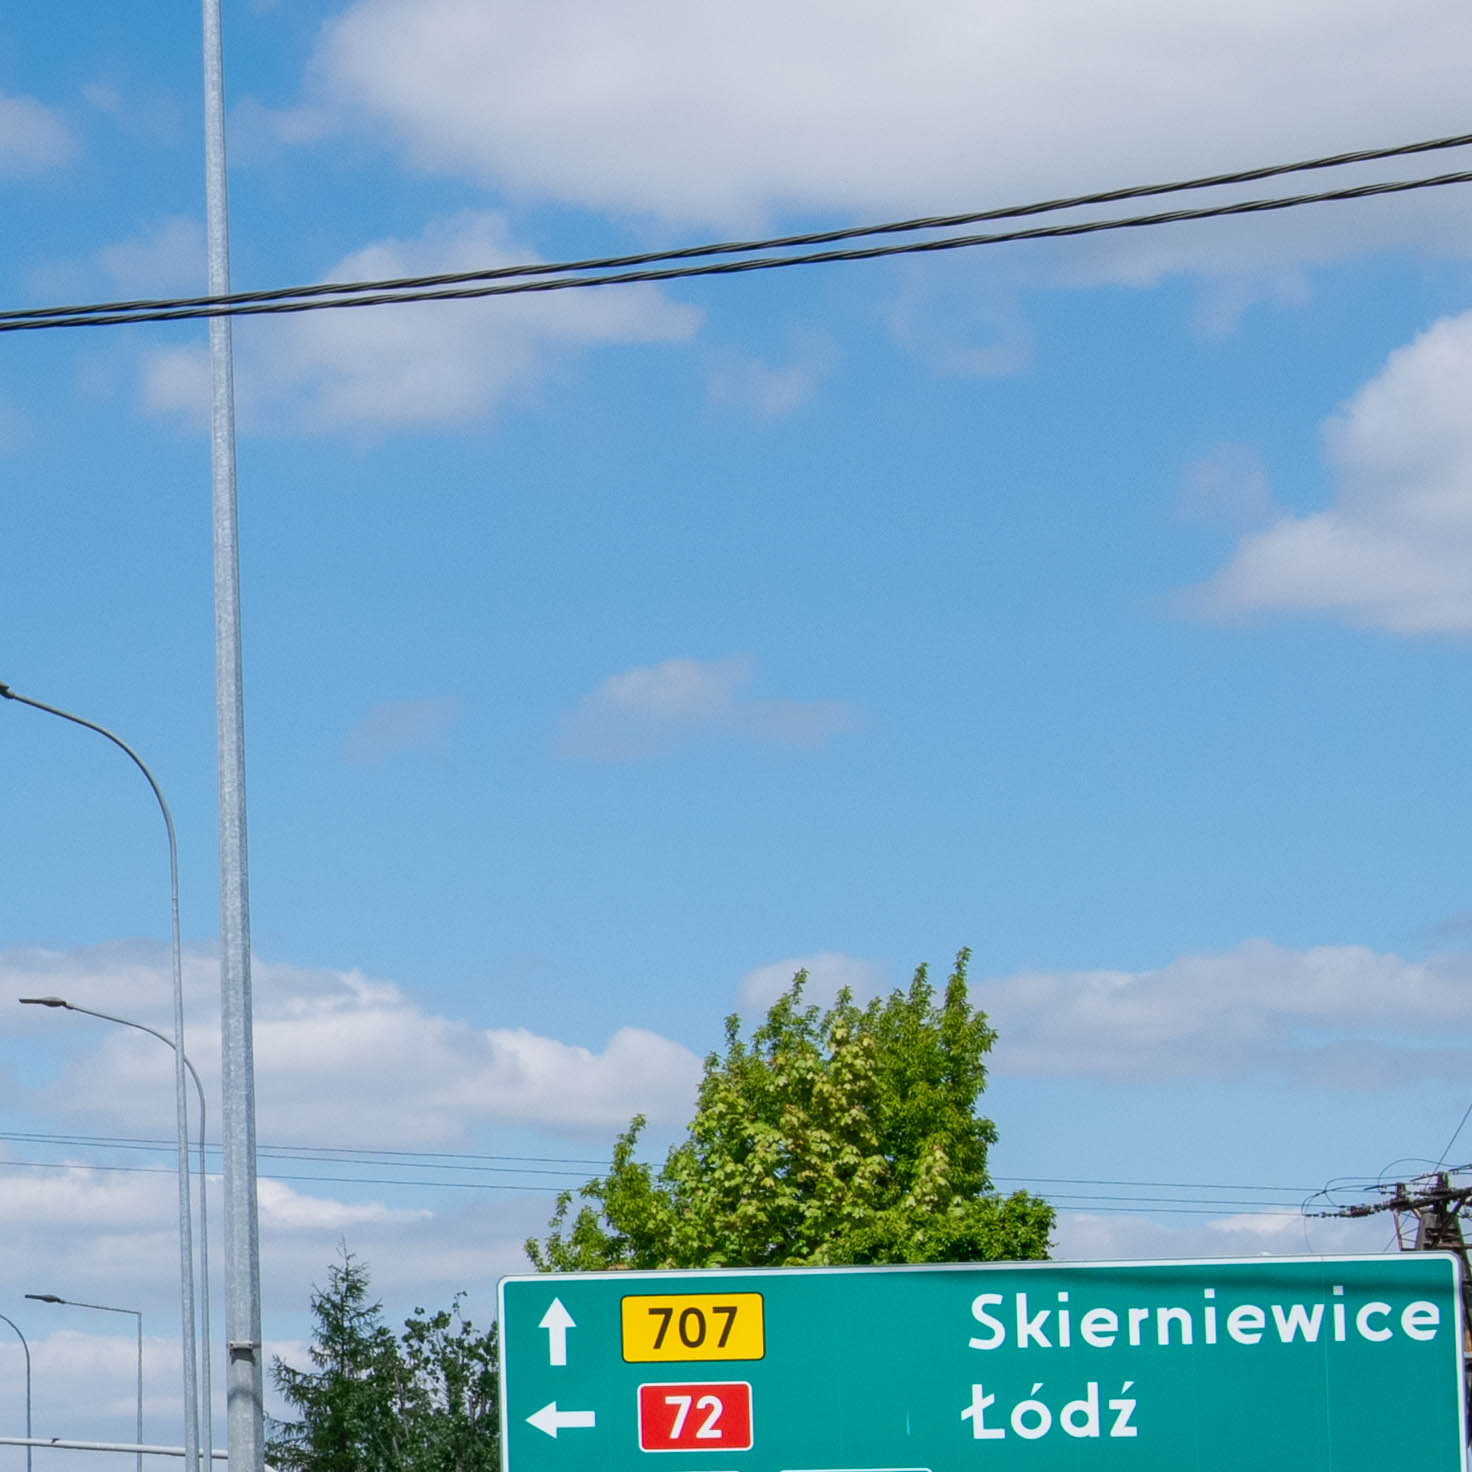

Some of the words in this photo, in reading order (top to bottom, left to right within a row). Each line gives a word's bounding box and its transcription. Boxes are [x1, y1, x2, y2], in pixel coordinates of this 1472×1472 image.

[648, 1306, 738, 1349] 707
[967, 1285, 1441, 1351] Skierniewice
[664, 1395, 724, 1440] 72
[960, 1381, 1138, 1440] Łódź
